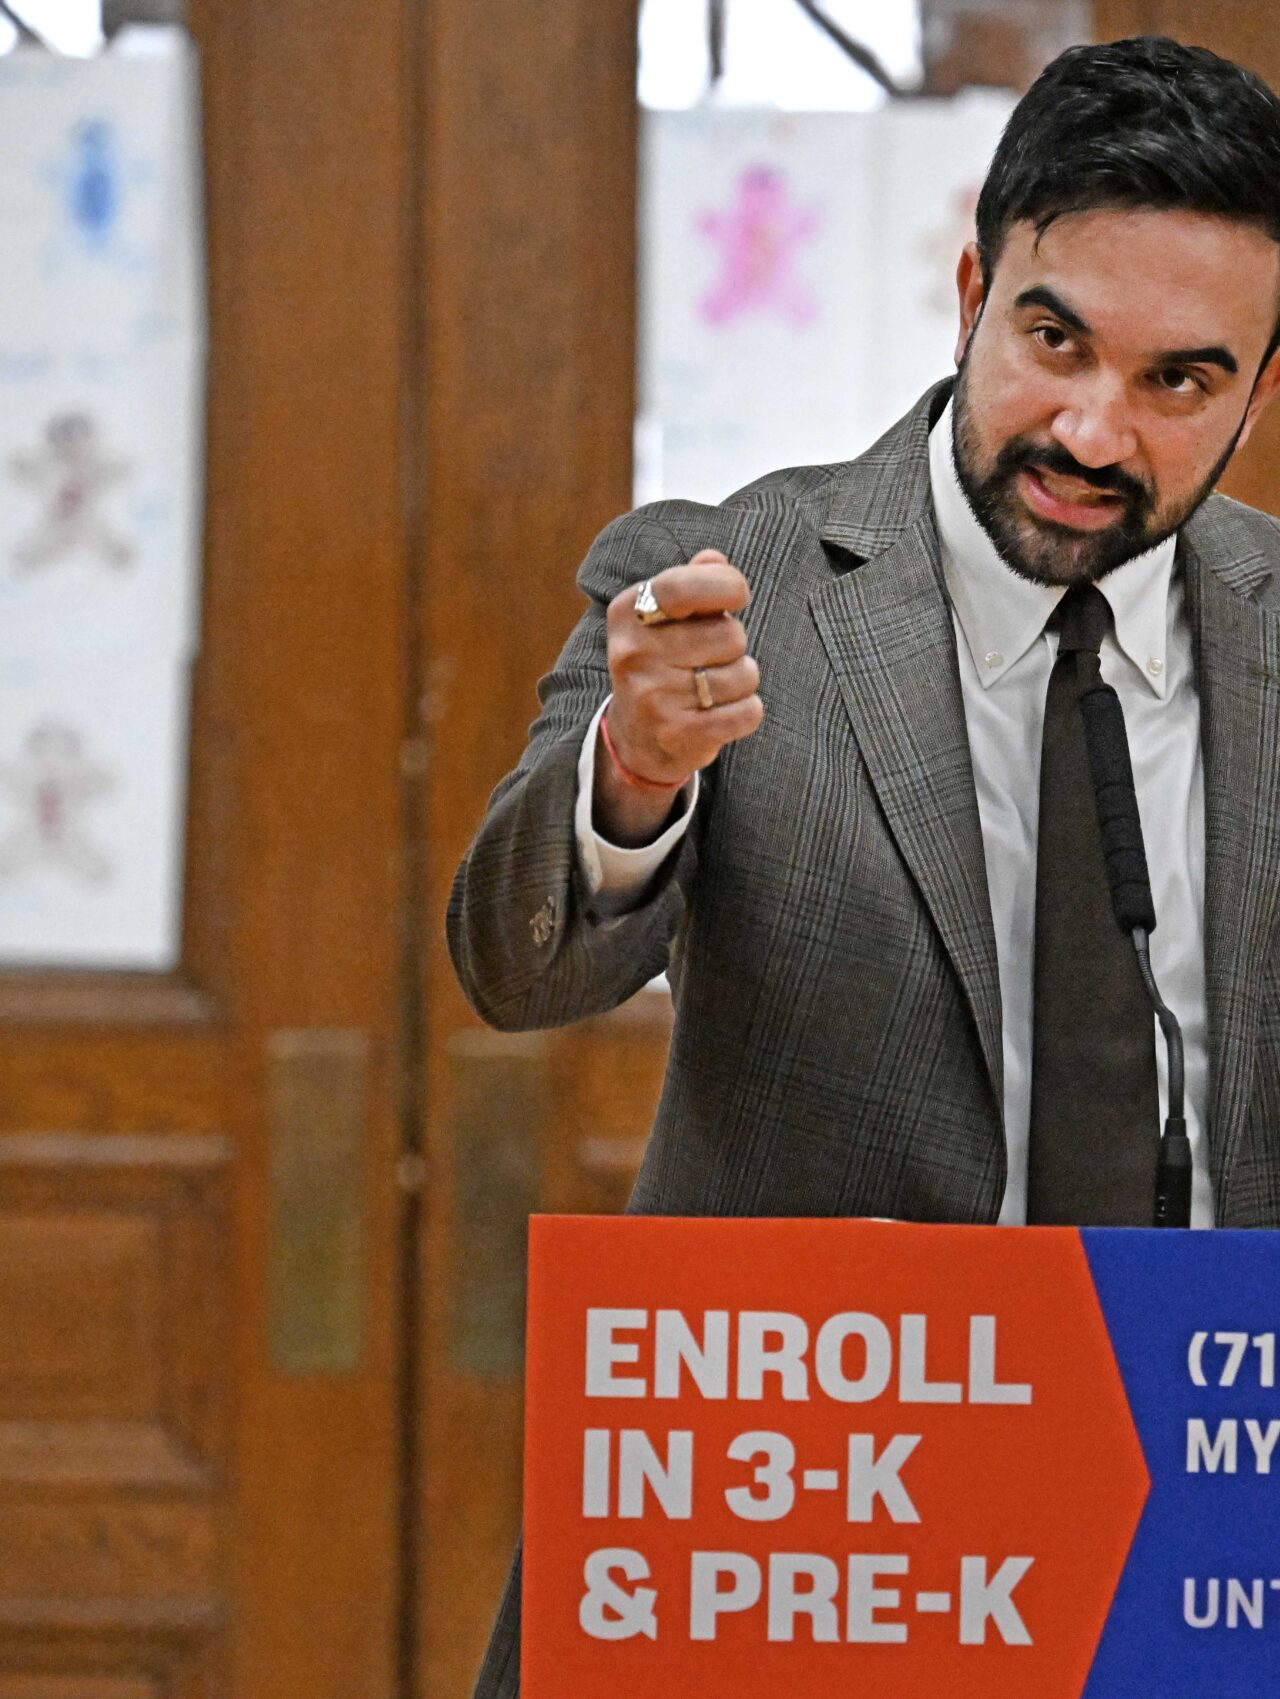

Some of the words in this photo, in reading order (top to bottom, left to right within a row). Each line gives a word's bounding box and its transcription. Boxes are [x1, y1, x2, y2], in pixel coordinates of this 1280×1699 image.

[585, 1308, 1032, 1405] ENROLL
[583, 1429, 693, 1519] IN
[725, 1431, 922, 1523] 3-K
[579, 1548, 658, 1640] &
[690, 1551, 1034, 1646] PRE-K
